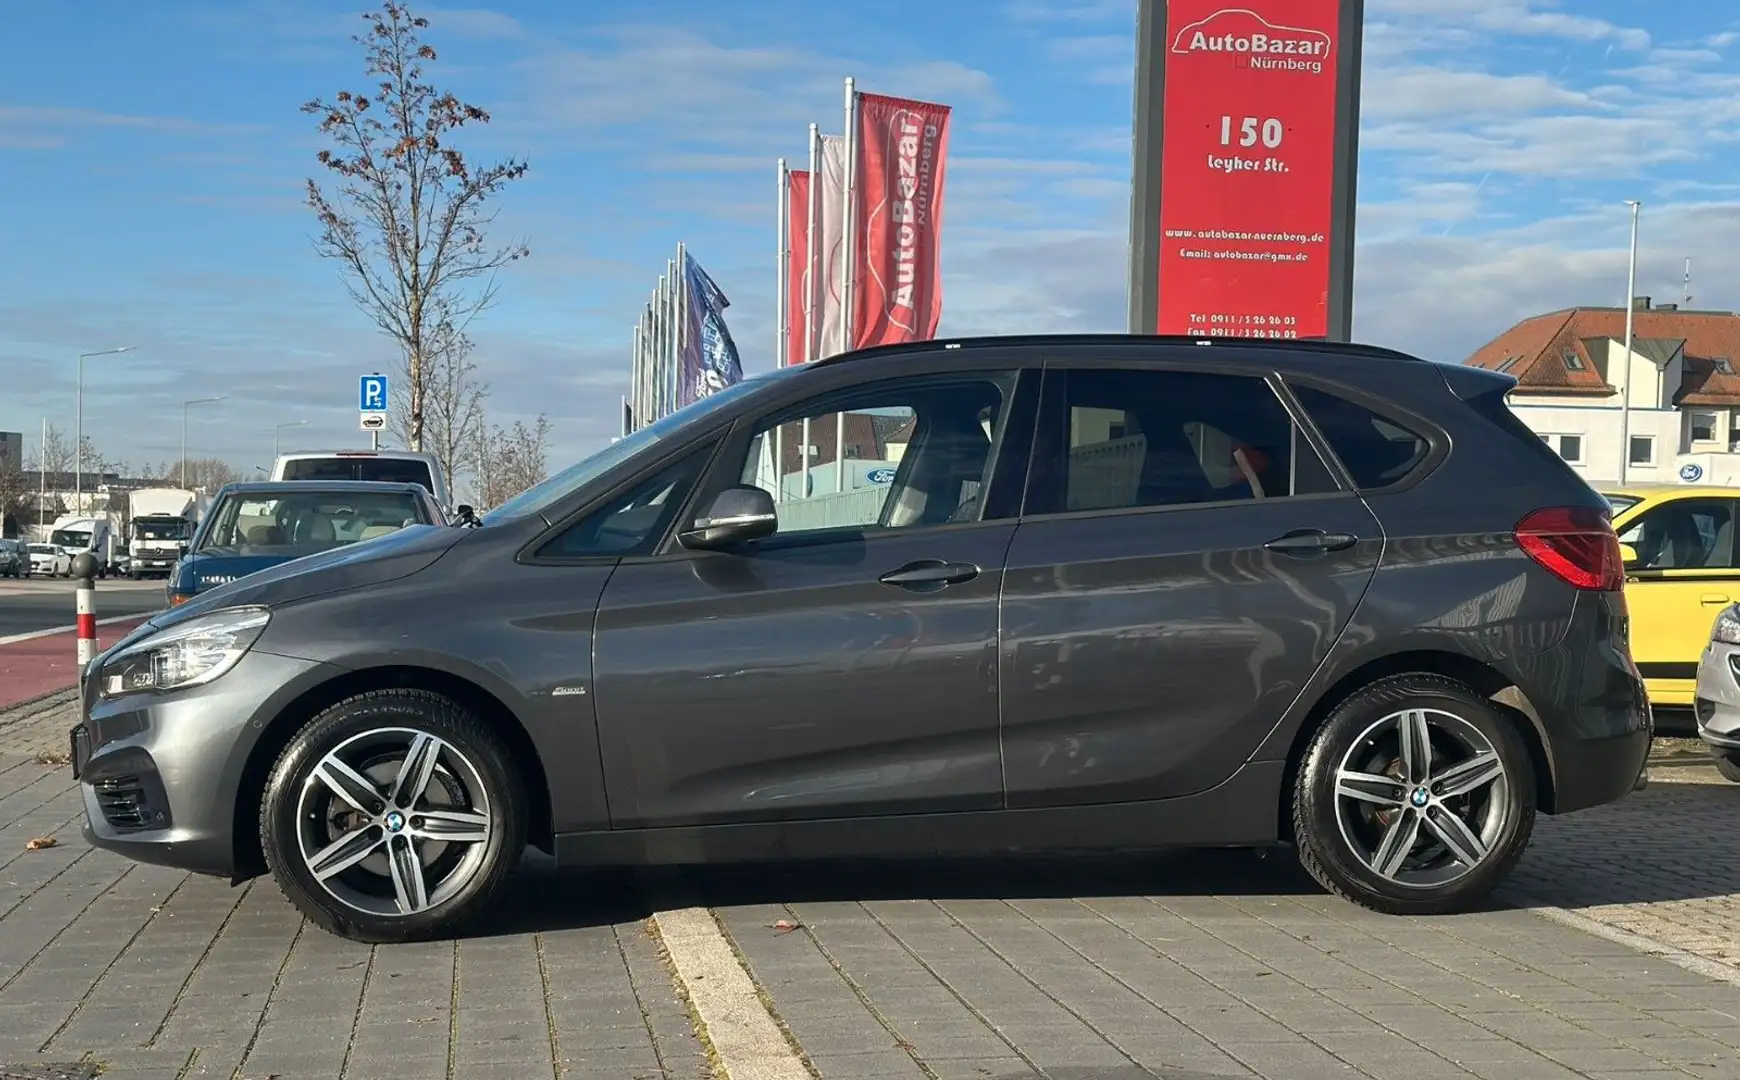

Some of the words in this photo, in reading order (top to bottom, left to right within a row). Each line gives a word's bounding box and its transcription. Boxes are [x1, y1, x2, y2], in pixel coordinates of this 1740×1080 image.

[1189, 31, 1325, 55] AutoBazar
[1250, 56, 1322, 73] Nürnberg
[1221, 115, 1283, 148] 150
[1208, 154, 1260, 173] Leyher
[1264, 157, 1290, 172] Str.
[891, 116, 919, 309] AutoBazar
[1165, 229, 1324, 244] www.autobazar-nuernberg.de
[1179, 248, 1211, 259] Email:
[1213, 249, 1308, 263] autobazar@gmx.de
[1190, 314, 1206, 323] Tel
[1253, 315, 1266, 325] 26
[1268, 316, 1281, 325] 26
[1253, 329, 1266, 338] 26
[1268, 329, 1281, 339] 26
[366, 379, 381, 406] P
[873, 470, 895, 482] For
